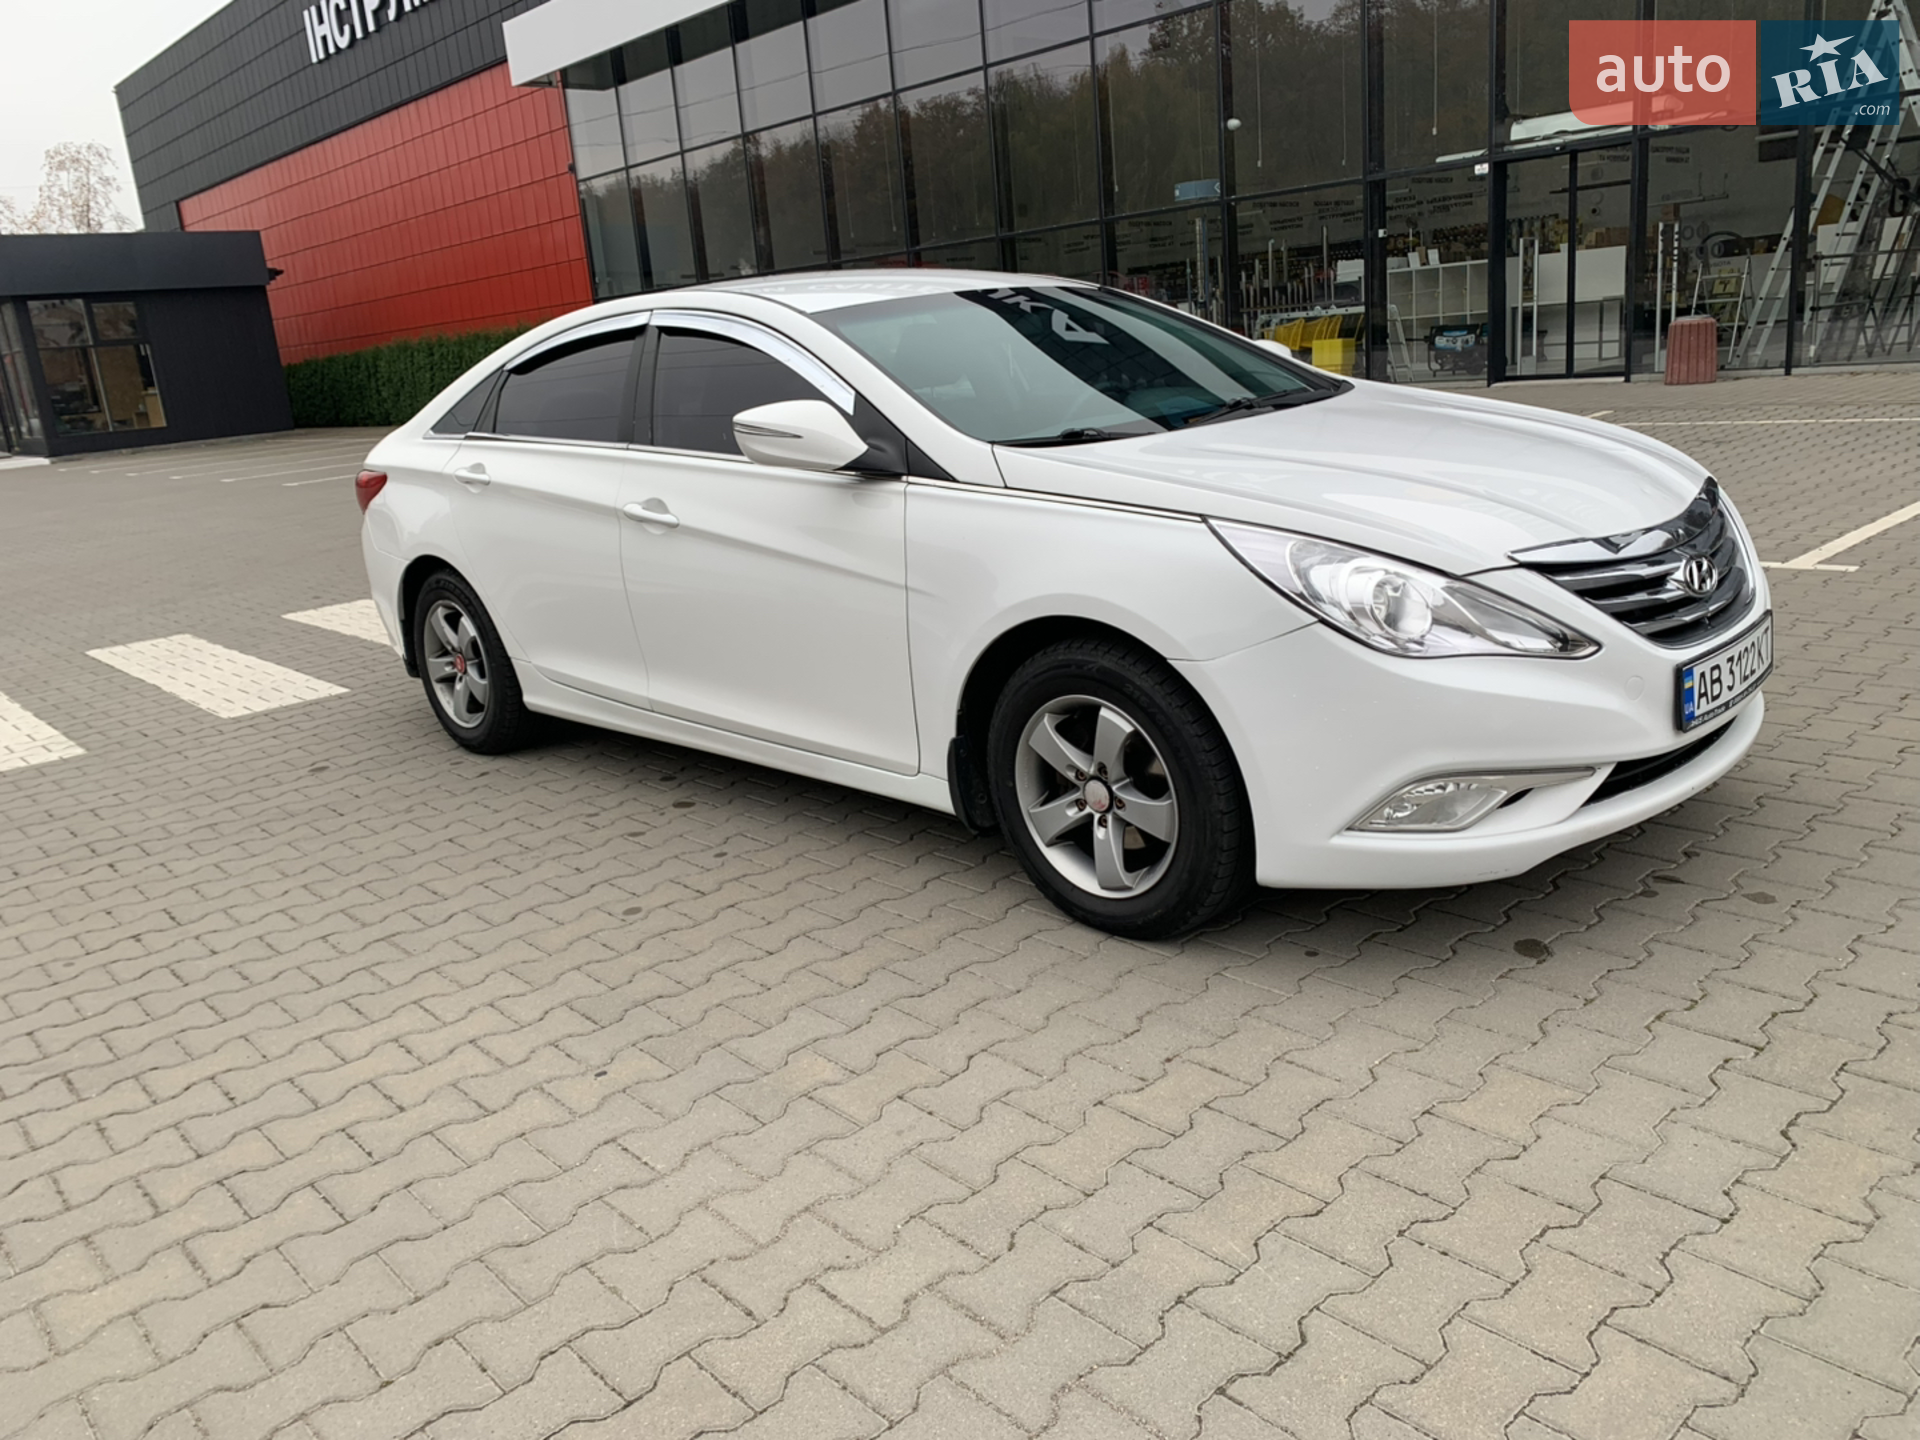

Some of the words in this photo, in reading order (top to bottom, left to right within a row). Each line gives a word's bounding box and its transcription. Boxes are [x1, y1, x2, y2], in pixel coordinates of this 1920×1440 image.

[302, 0, 430, 64] ІНСТР
[1696, 663, 1723, 710] AB
[1726, 640, 1757, 692] 3122
[1757, 627, 1770, 670] KT
